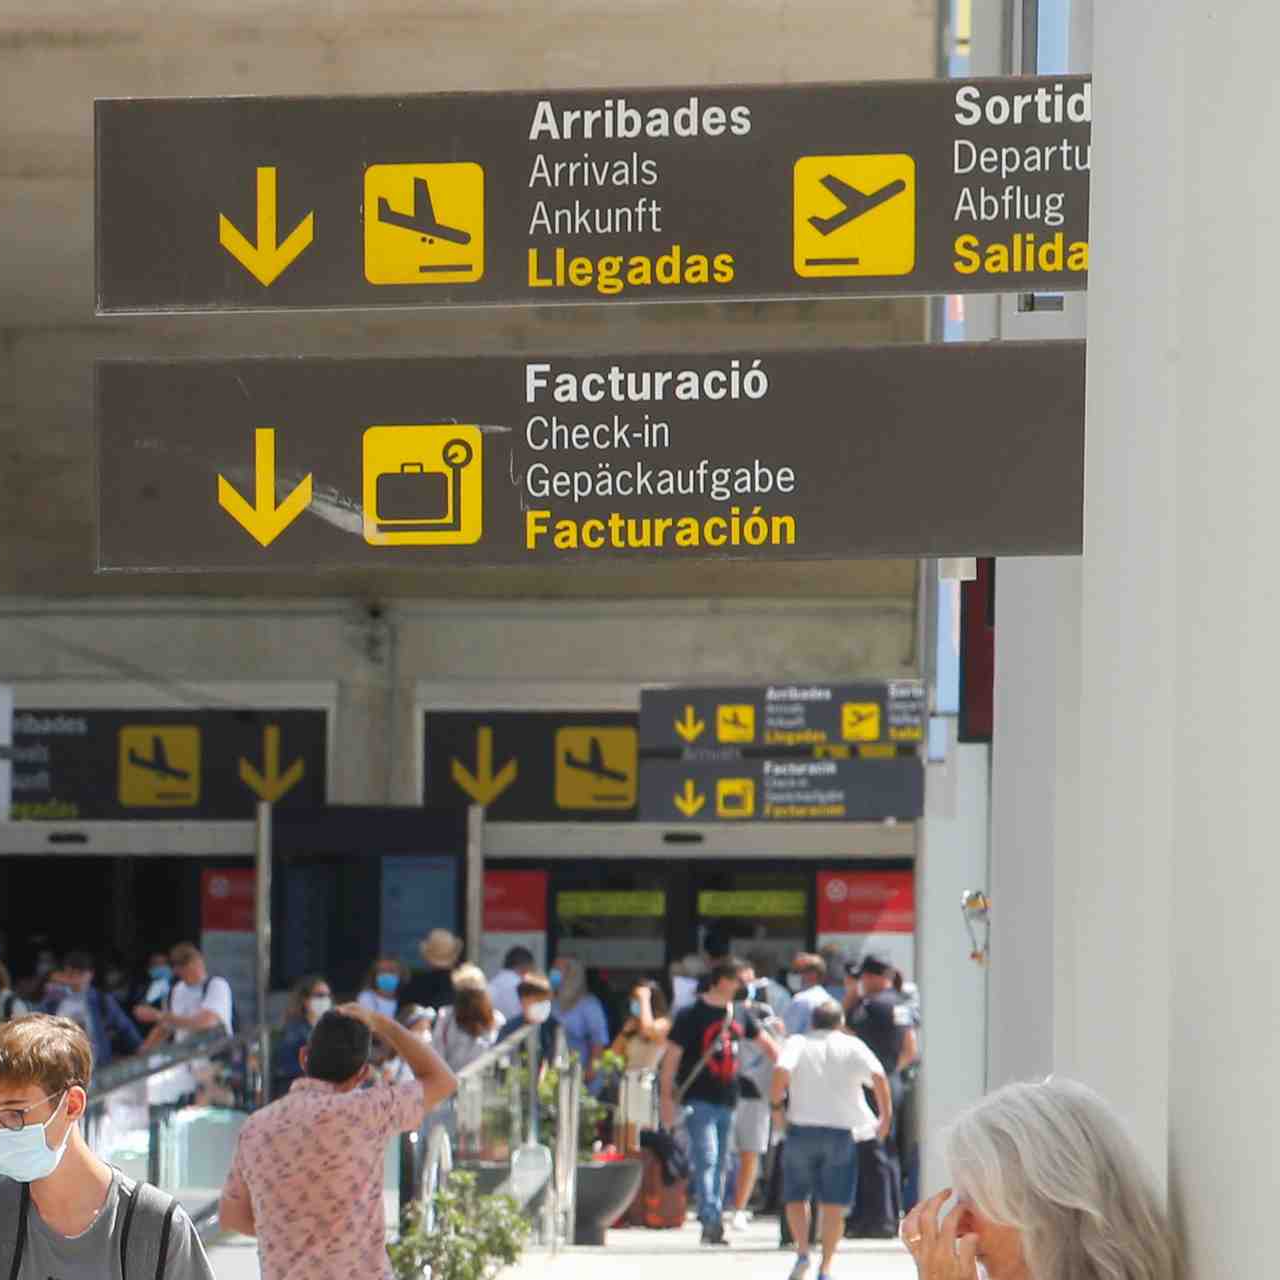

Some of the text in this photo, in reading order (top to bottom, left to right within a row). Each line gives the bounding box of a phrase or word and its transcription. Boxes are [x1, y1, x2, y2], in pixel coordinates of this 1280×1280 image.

[528, 99, 752, 142] Arribades
[528, 151, 659, 189] Arrivals
[528, 196, 663, 236] Ankunft
[953, 184, 1067, 228] Abflug
[527, 246, 736, 291] Llegadas
[952, 230, 1089, 275] Salida
[525, 357, 770, 404] Facturació
[525, 413, 671, 452] Check-in
[525, 458, 796, 503] Gepäckaufgabe
[525, 505, 797, 550] Facturación
